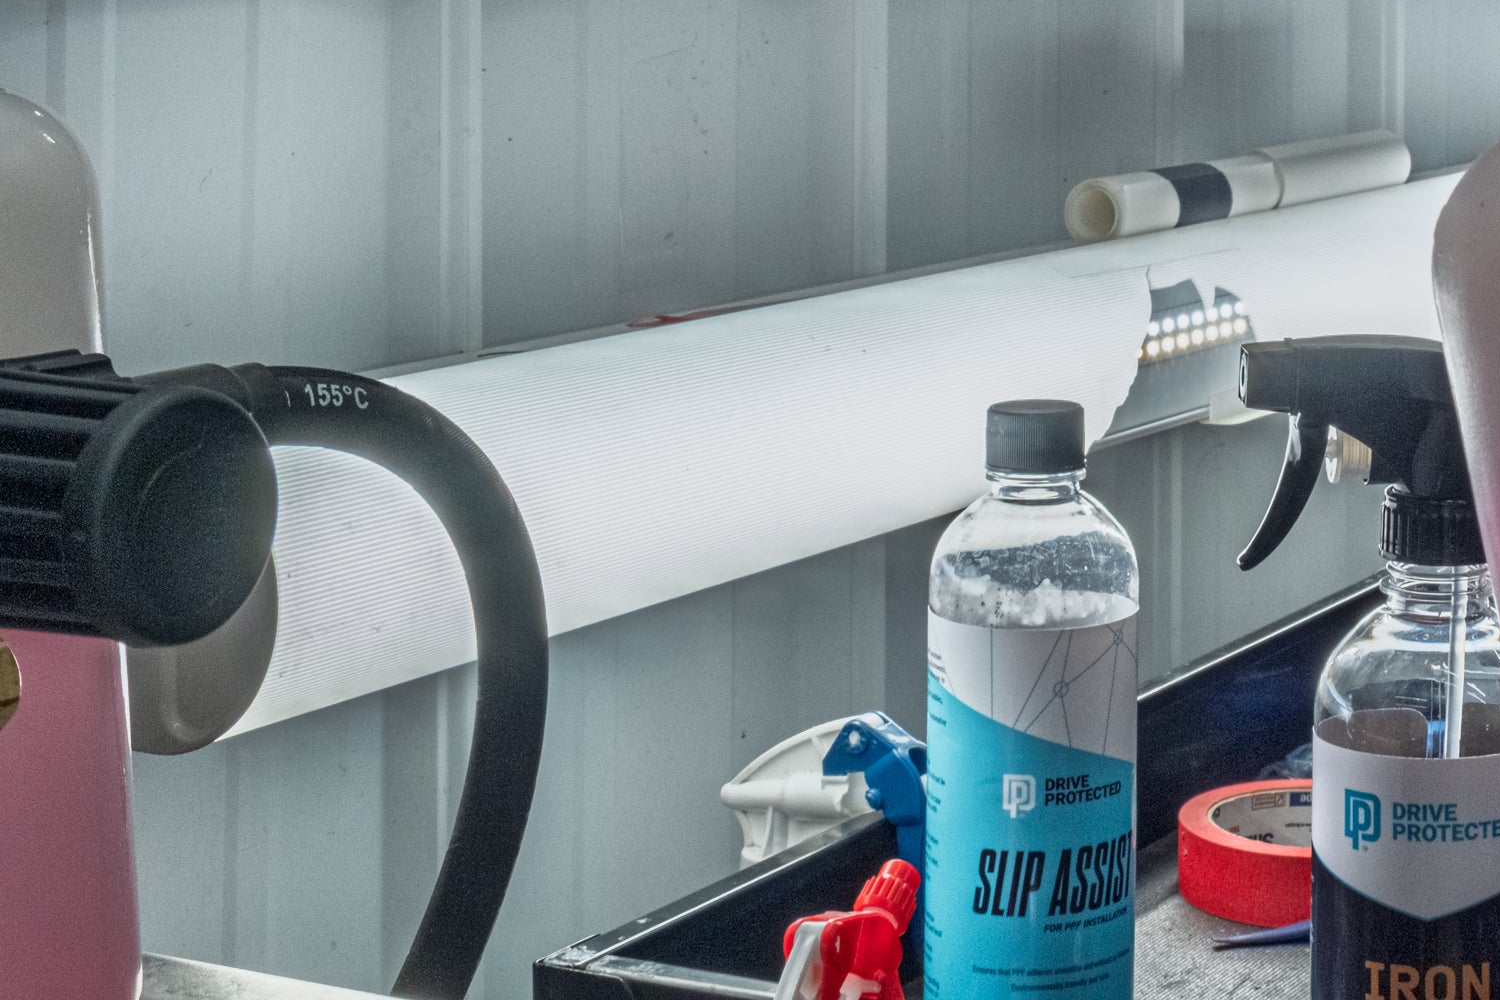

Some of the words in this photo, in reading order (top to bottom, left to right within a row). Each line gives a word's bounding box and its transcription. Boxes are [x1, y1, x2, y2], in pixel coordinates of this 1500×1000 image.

[304, 383, 369, 410] 155°C
[1044, 774, 1090, 793] DRIVE
[1044, 781, 1122, 806] PROTECTED
[1392, 802, 1458, 822] DRIVE
[972, 848, 1046, 918] SLIP
[1048, 830, 1133, 917] ASSIST
[1043, 923, 1063, 933] FOR
[1064, 920, 1082, 931] PPF
[1364, 960, 1491, 1000] IRON
